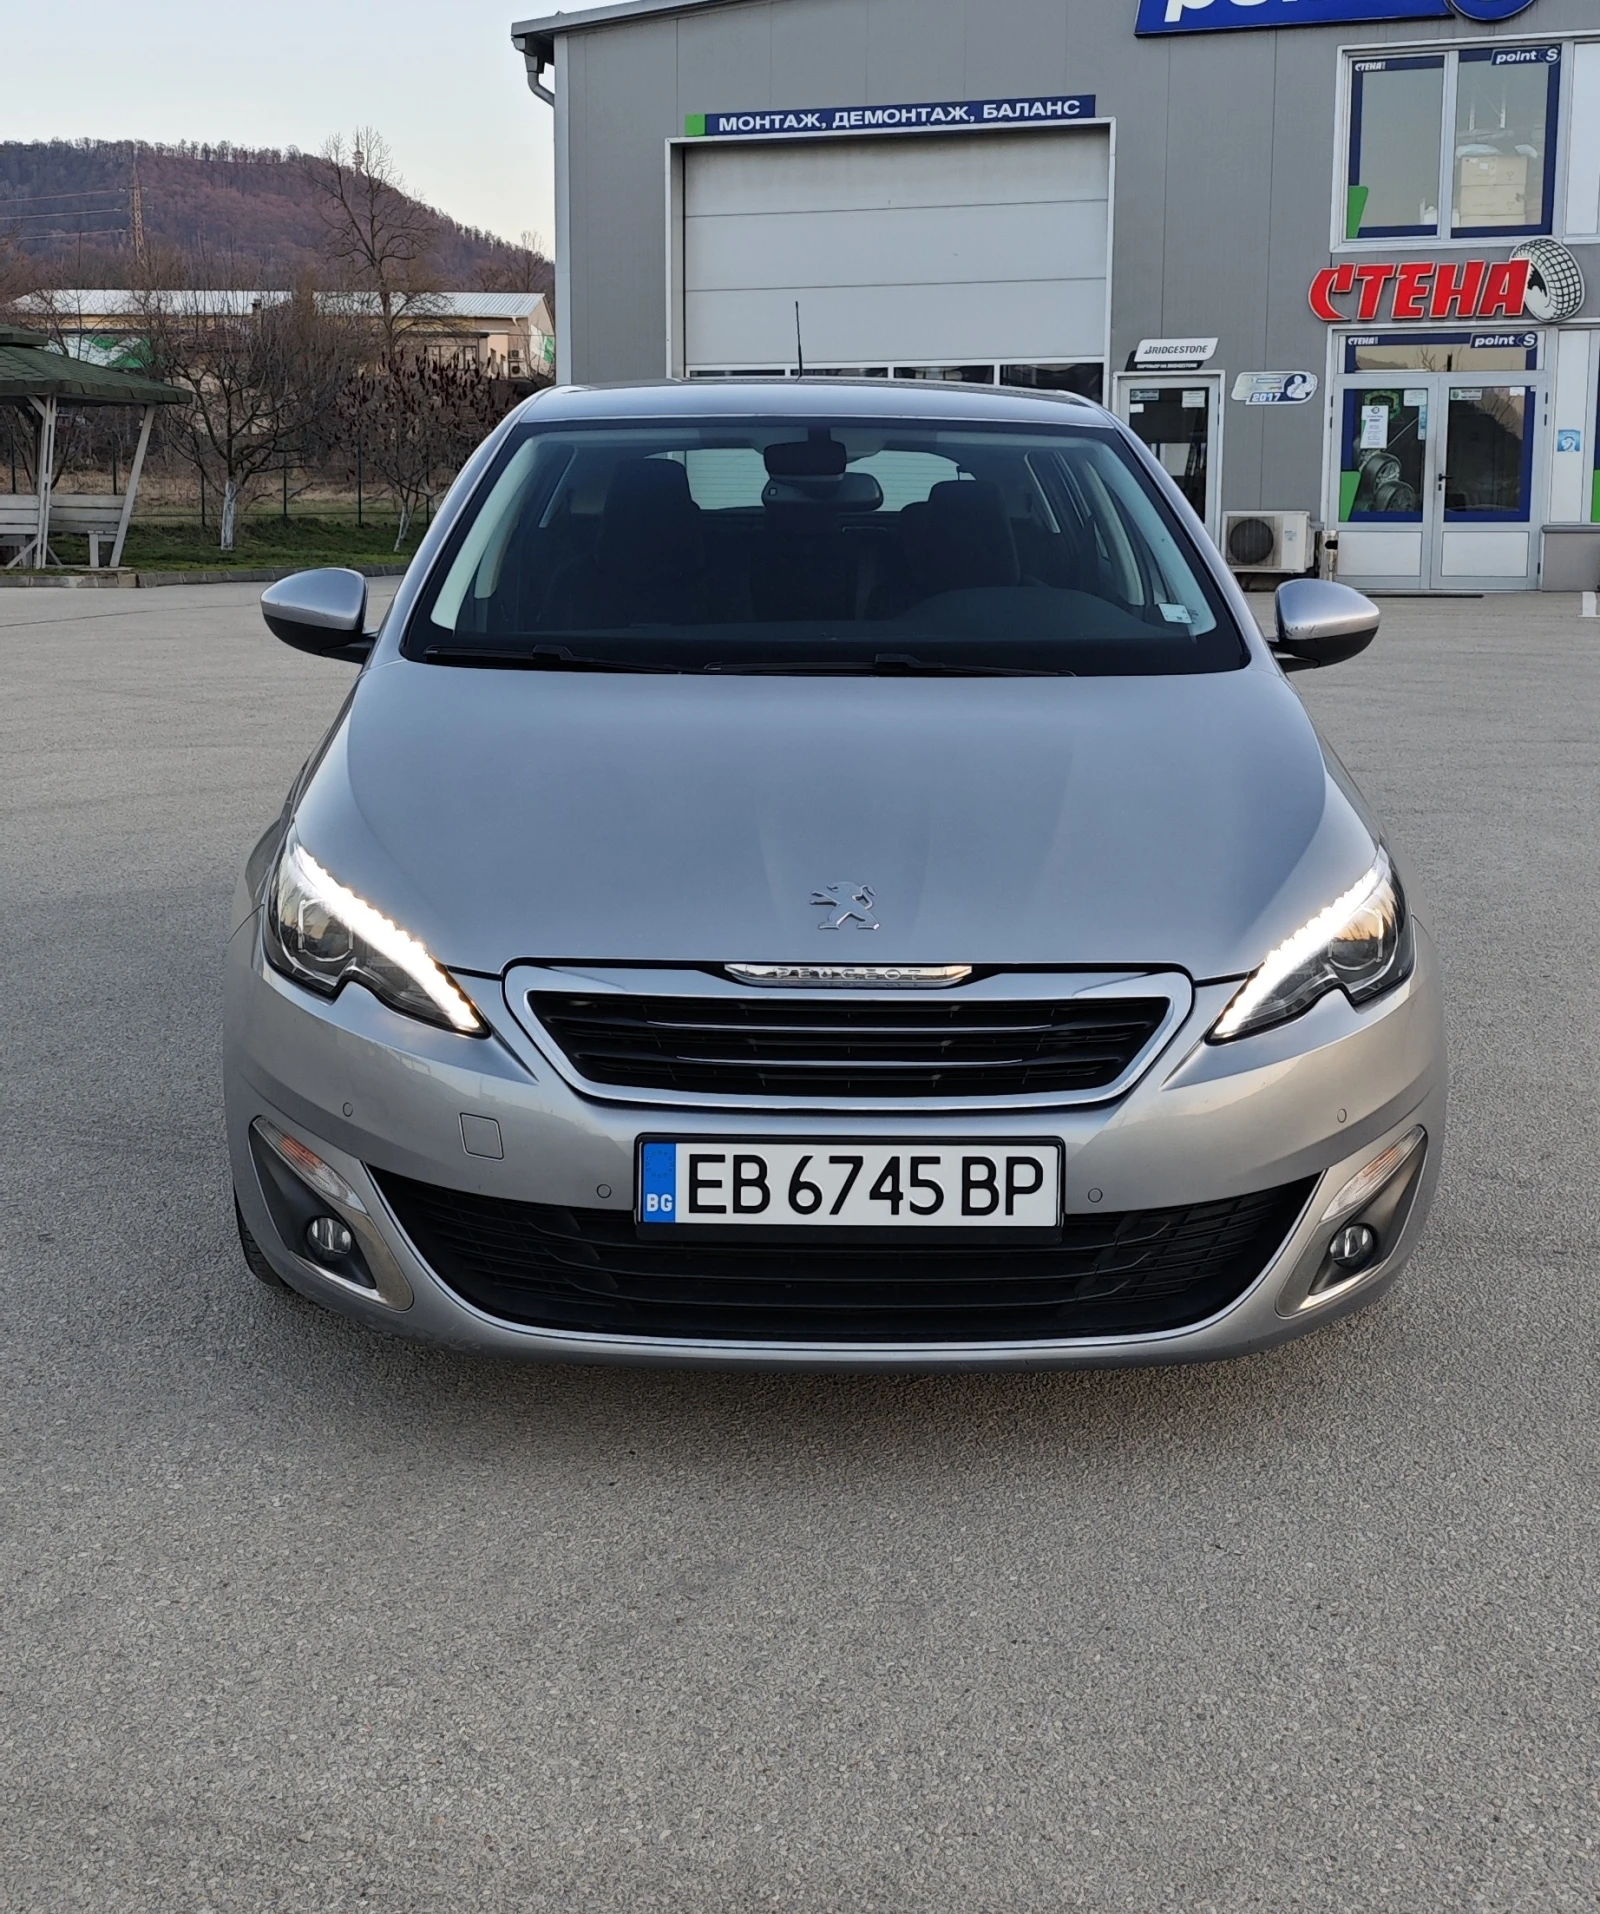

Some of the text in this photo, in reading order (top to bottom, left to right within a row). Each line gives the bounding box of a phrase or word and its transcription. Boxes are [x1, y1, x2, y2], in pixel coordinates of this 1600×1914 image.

[1495, 49, 1558, 65] point S
[719, 100, 1081, 132] МОНТАЖ, ДЕМОНТАЖ, БАЛАНС
[1308, 258, 1532, 321] СТЕНА
[1474, 333, 1536, 348] point S
[1143, 345, 1208, 355] BRIDGESTONE
[1251, 393, 1281, 402] 2017
[775, 967, 922, 980] PEUGEOT
[688, 1153, 1044, 1217] EB 6745 BP
[646, 1193, 674, 1213] BG
